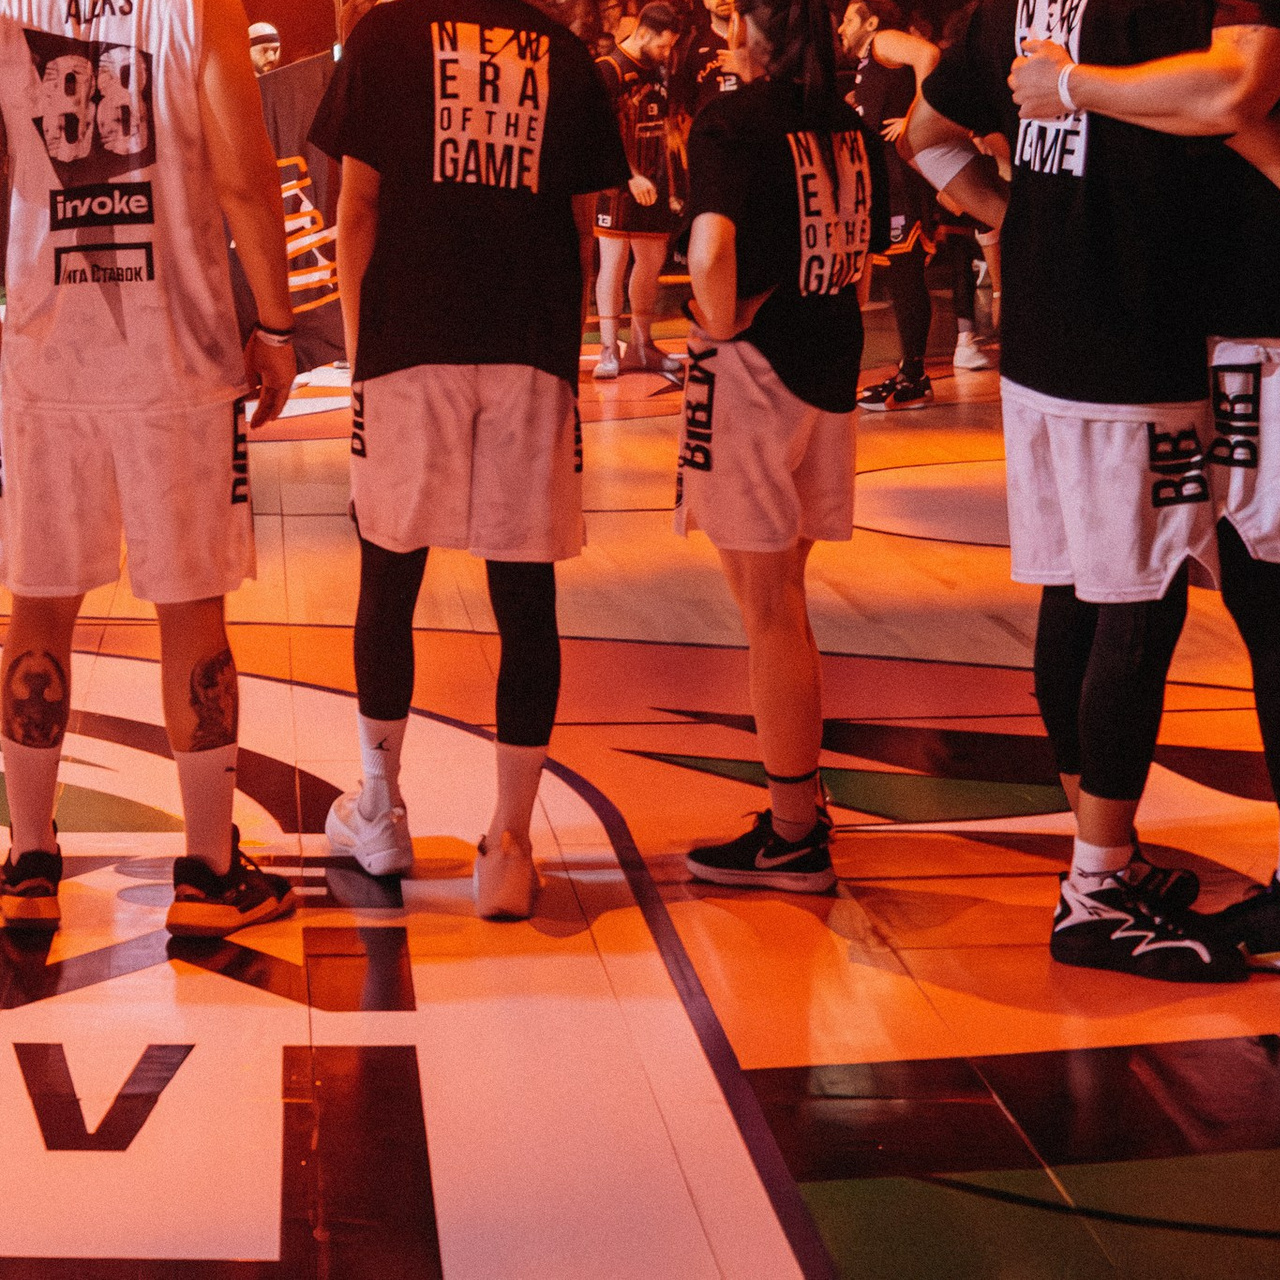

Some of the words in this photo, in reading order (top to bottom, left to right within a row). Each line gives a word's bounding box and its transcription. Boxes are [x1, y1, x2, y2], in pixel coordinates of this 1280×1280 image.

[438, 22, 547, 62] NEW
[440, 59, 539, 110] ERA
[716, 75, 738, 92] 12
[42, 45, 149, 163] 88
[440, 107, 472, 132] OF
[485, 111, 539, 142] THE
[440, 138, 534, 188] GAME
[56, 190, 149, 220] invoke
[801, 169, 866, 218] EA
[597, 214, 612, 228] 13
